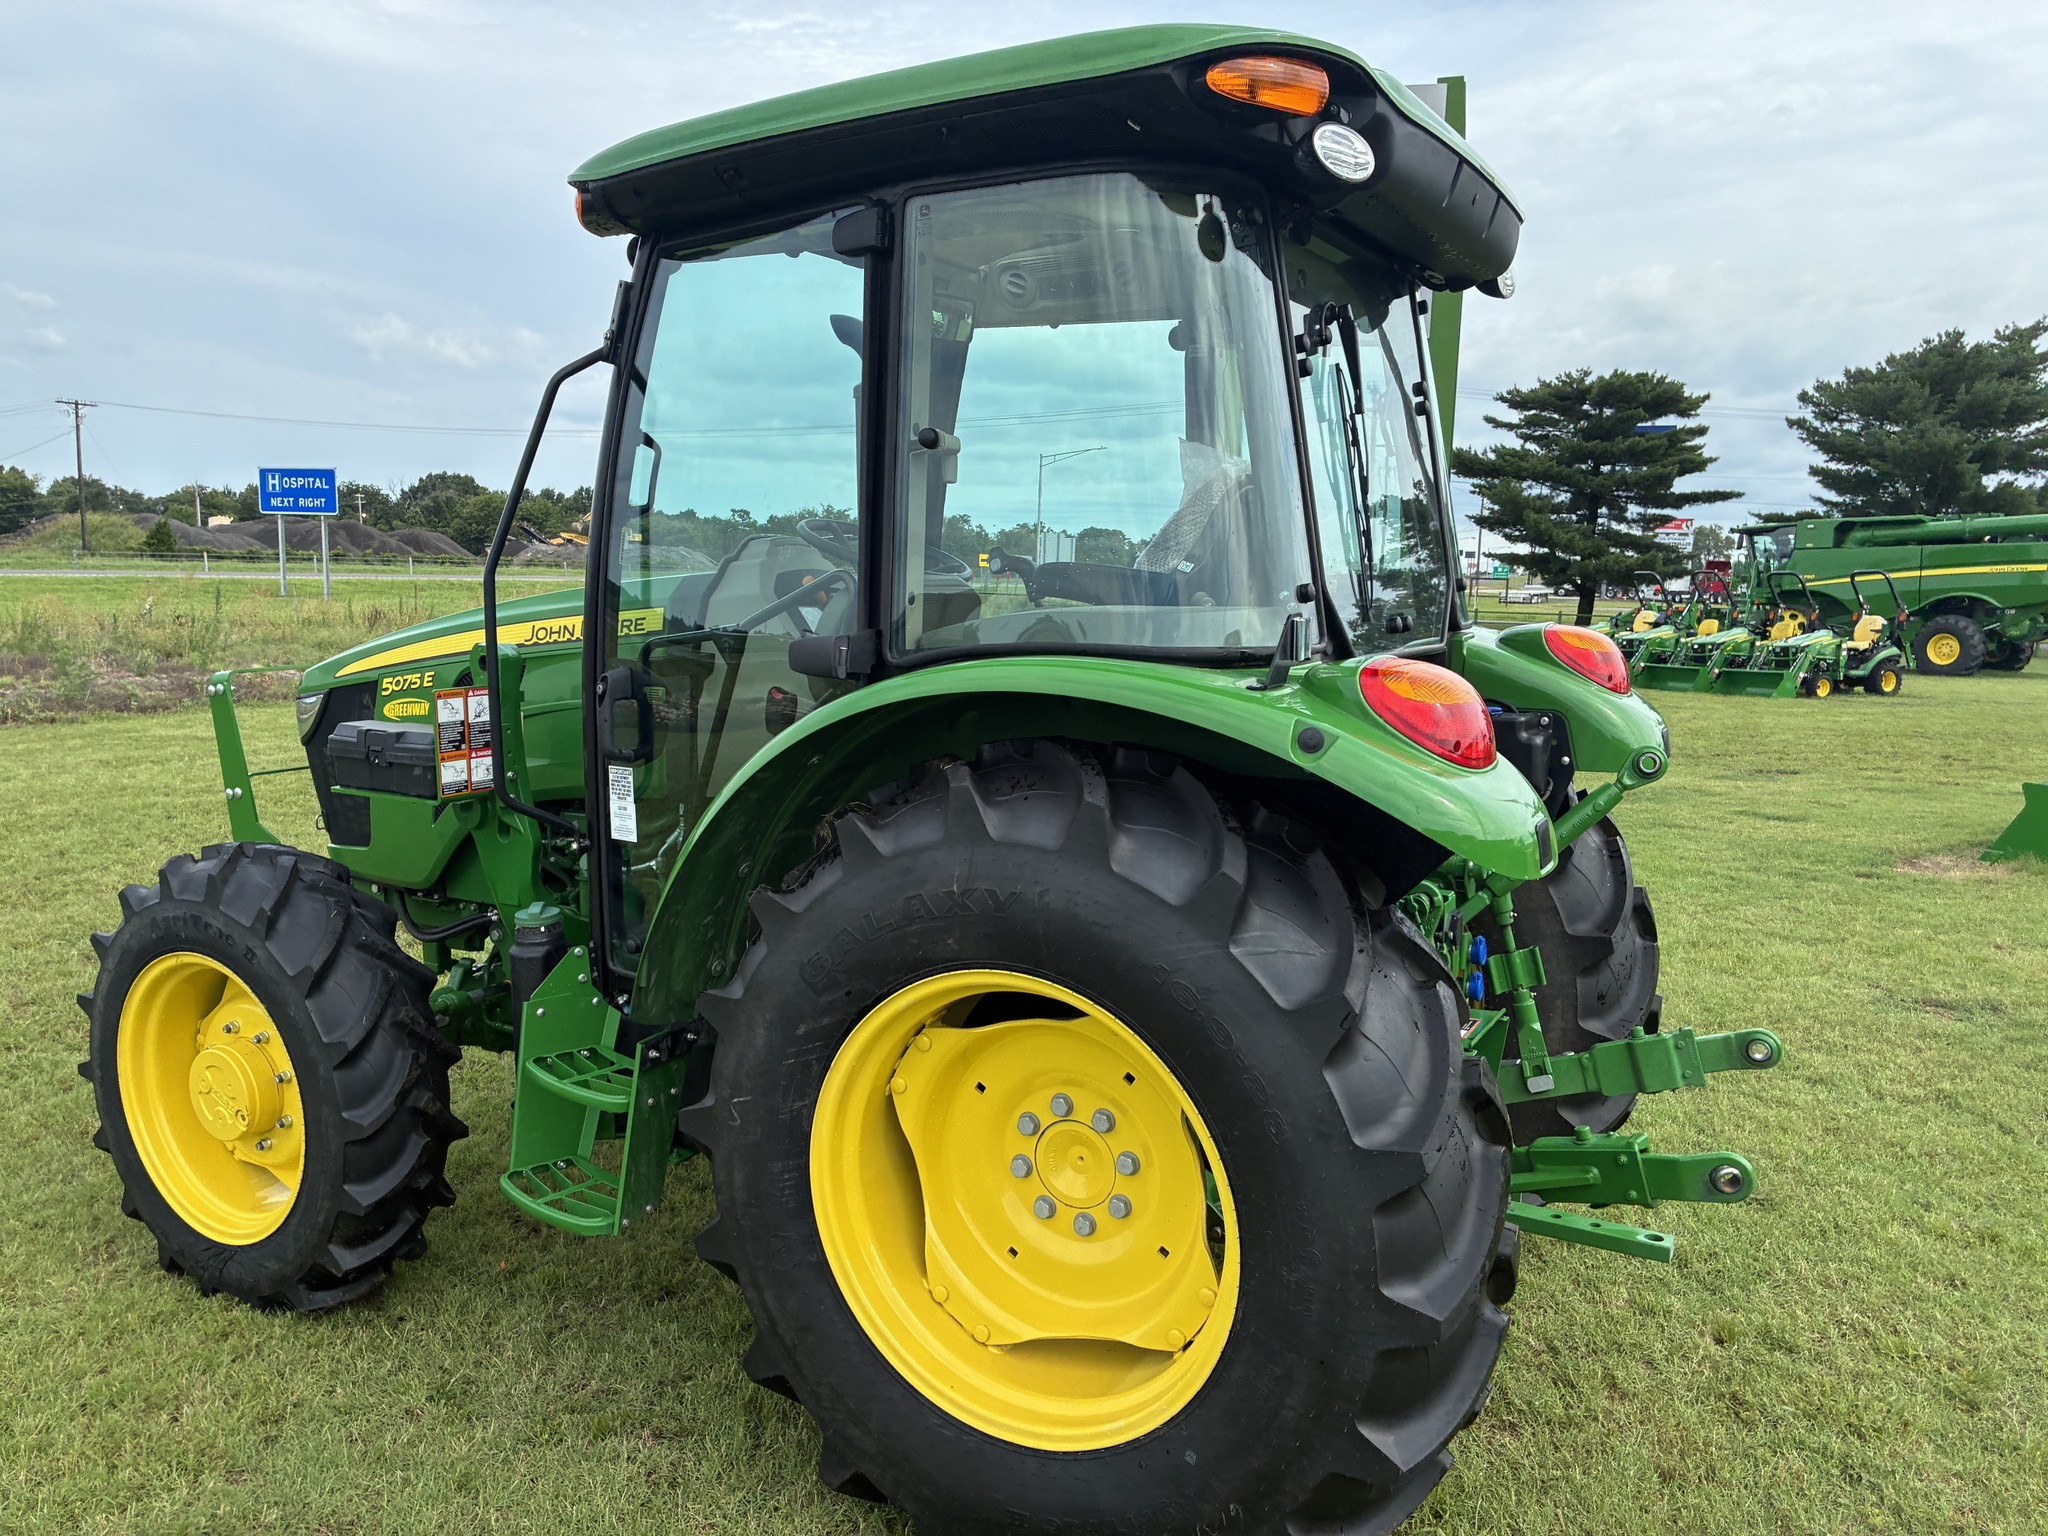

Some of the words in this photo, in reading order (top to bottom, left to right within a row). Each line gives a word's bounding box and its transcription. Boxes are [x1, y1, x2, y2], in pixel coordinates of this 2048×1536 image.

[268, 474, 329, 491] HOSPITAL
[271, 497, 294, 507] NEXT
[299, 498, 326, 507] RIGHT
[524, 624, 576, 643] JOHN
[381, 673, 421, 696] 5075
[423, 671, 435, 687] E
[390, 702, 430, 717] GREENWAY
[800, 886, 1023, 984] GALAXY
[1153, 962, 1290, 1165] 16.9-28
